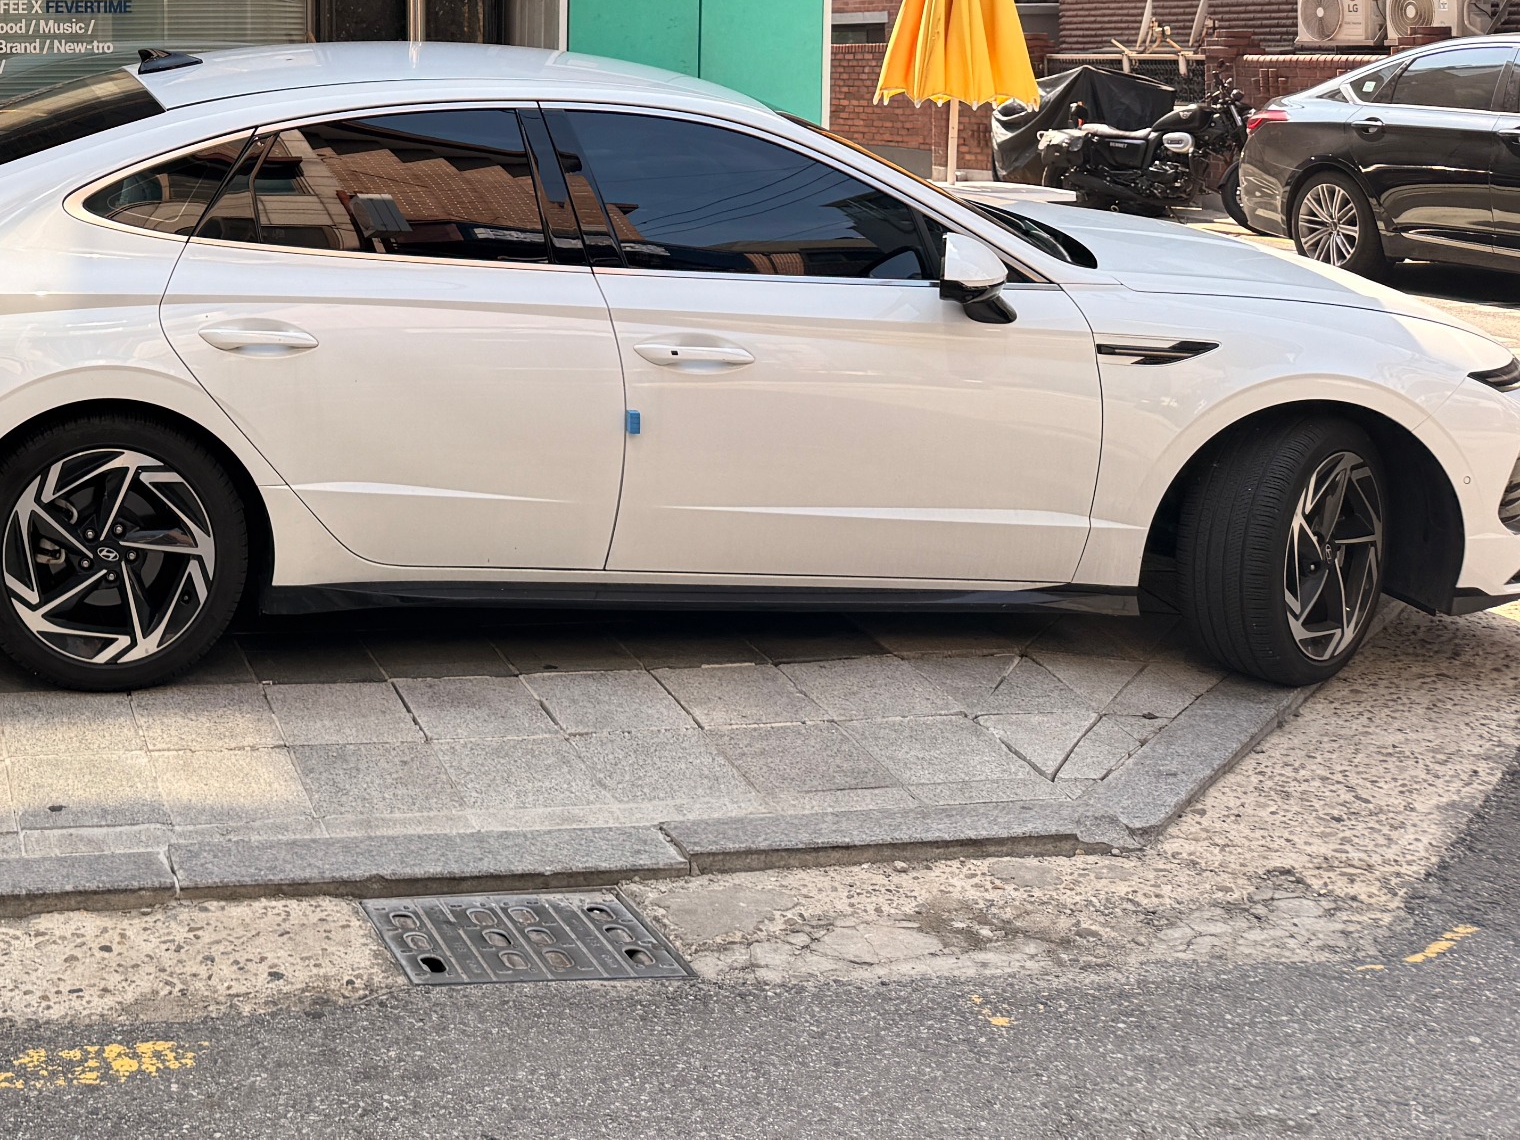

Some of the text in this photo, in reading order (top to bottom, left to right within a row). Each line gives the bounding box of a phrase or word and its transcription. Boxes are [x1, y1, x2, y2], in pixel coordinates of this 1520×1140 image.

[31, 0, 42, 14] X
[45, 0, 133, 14] FEVERTIME
[1347, 3, 1359, 13] LG
[39, 19, 85, 34] Music
[53, 40, 114, 54] New-tro
